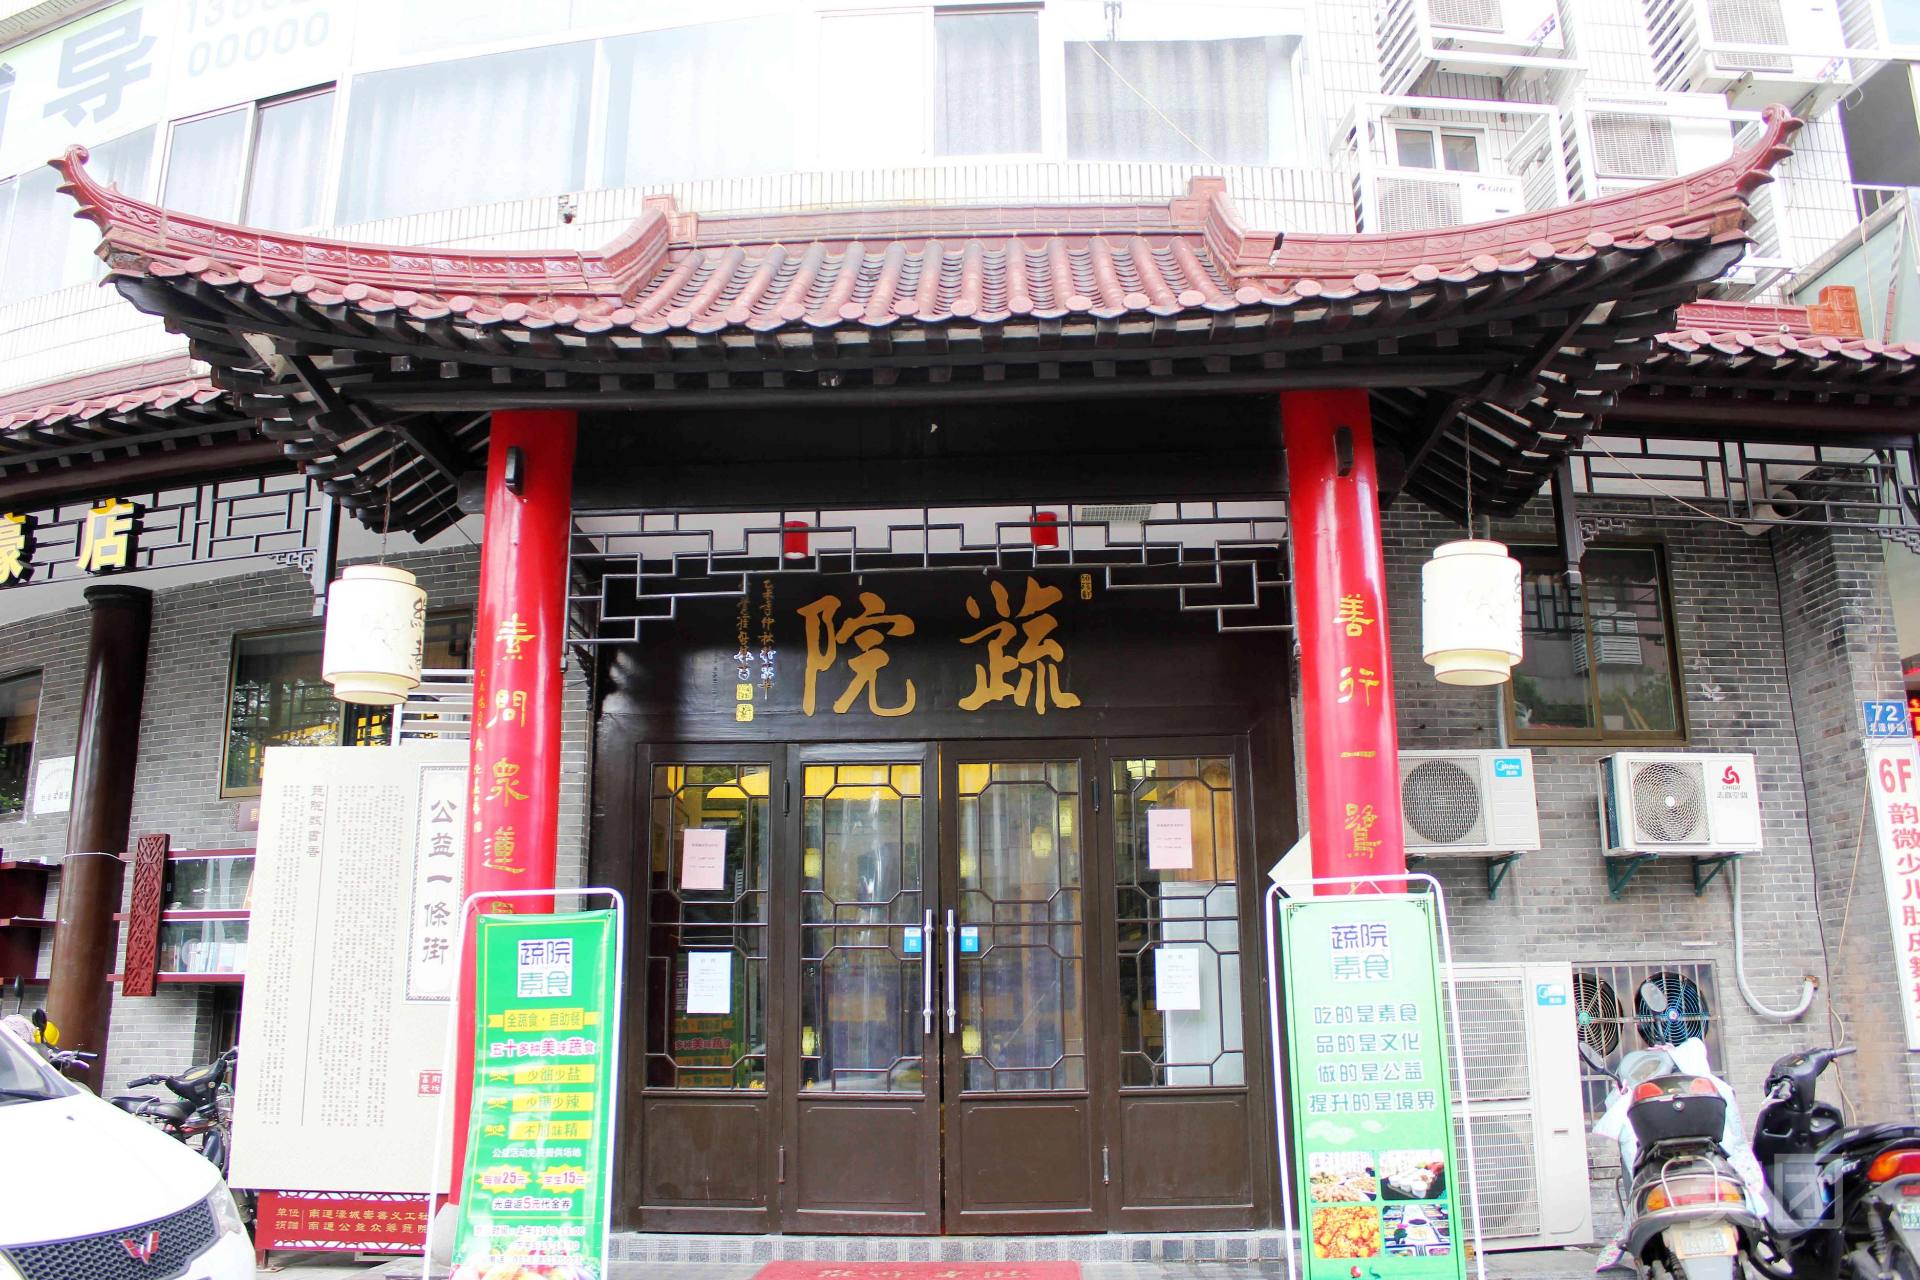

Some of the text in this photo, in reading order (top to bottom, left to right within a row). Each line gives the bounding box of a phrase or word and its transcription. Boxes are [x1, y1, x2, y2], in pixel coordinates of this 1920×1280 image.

[188, 11, 329, 77] 00000
[1871, 704, 1898, 721] 72
[1879, 758, 1912, 793] 6F
[1331, 923, 1388, 949] 蔬院
[520, 941, 570, 966] 蔬院
[1334, 954, 1390, 980] 素食
[520, 971, 569, 994] 素食
[1314, 1003, 1417, 1025] 吃的是素食
[1316, 1032, 1420, 1053] 品的是文化
[1318, 1061, 1423, 1083] 做的是公益
[1309, 1090, 1435, 1113] 提升的是境界
